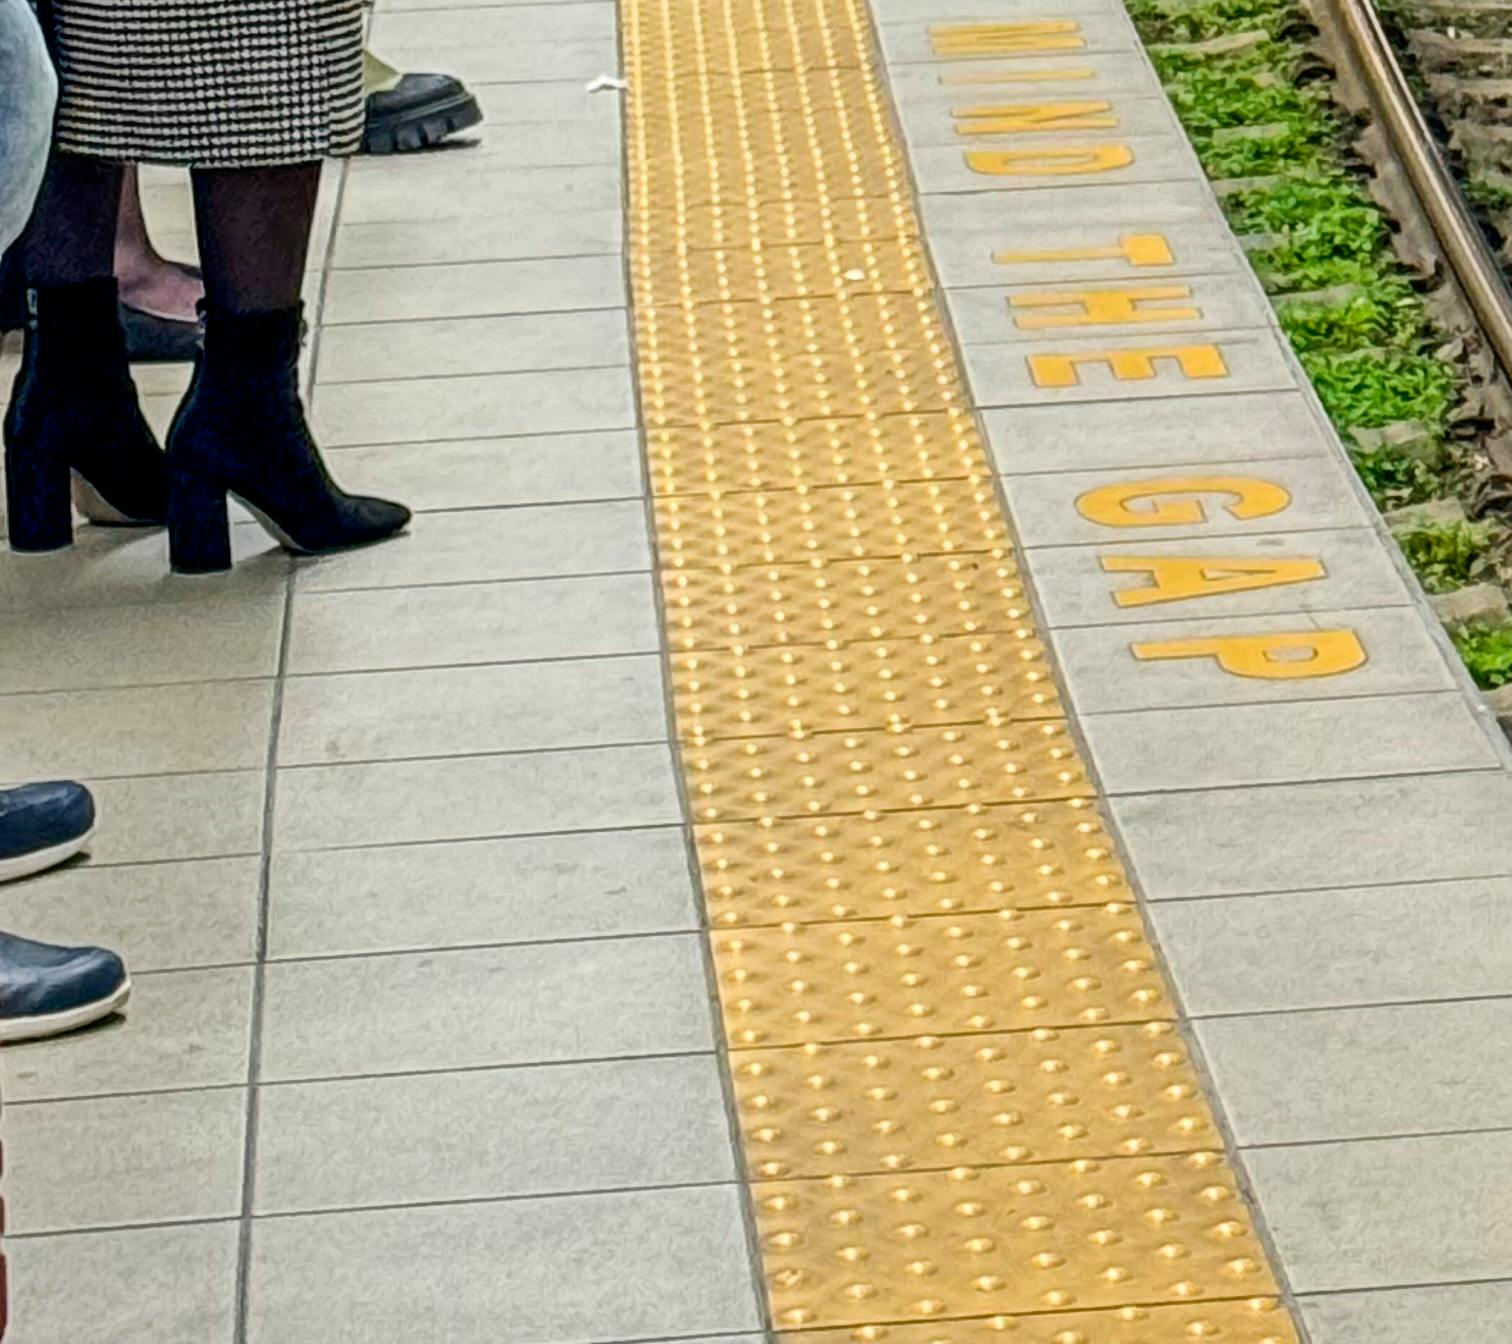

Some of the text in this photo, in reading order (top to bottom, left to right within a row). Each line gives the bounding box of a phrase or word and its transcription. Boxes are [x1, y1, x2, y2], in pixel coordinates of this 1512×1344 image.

[927, 19, 1369, 680] MIND THE GAP
